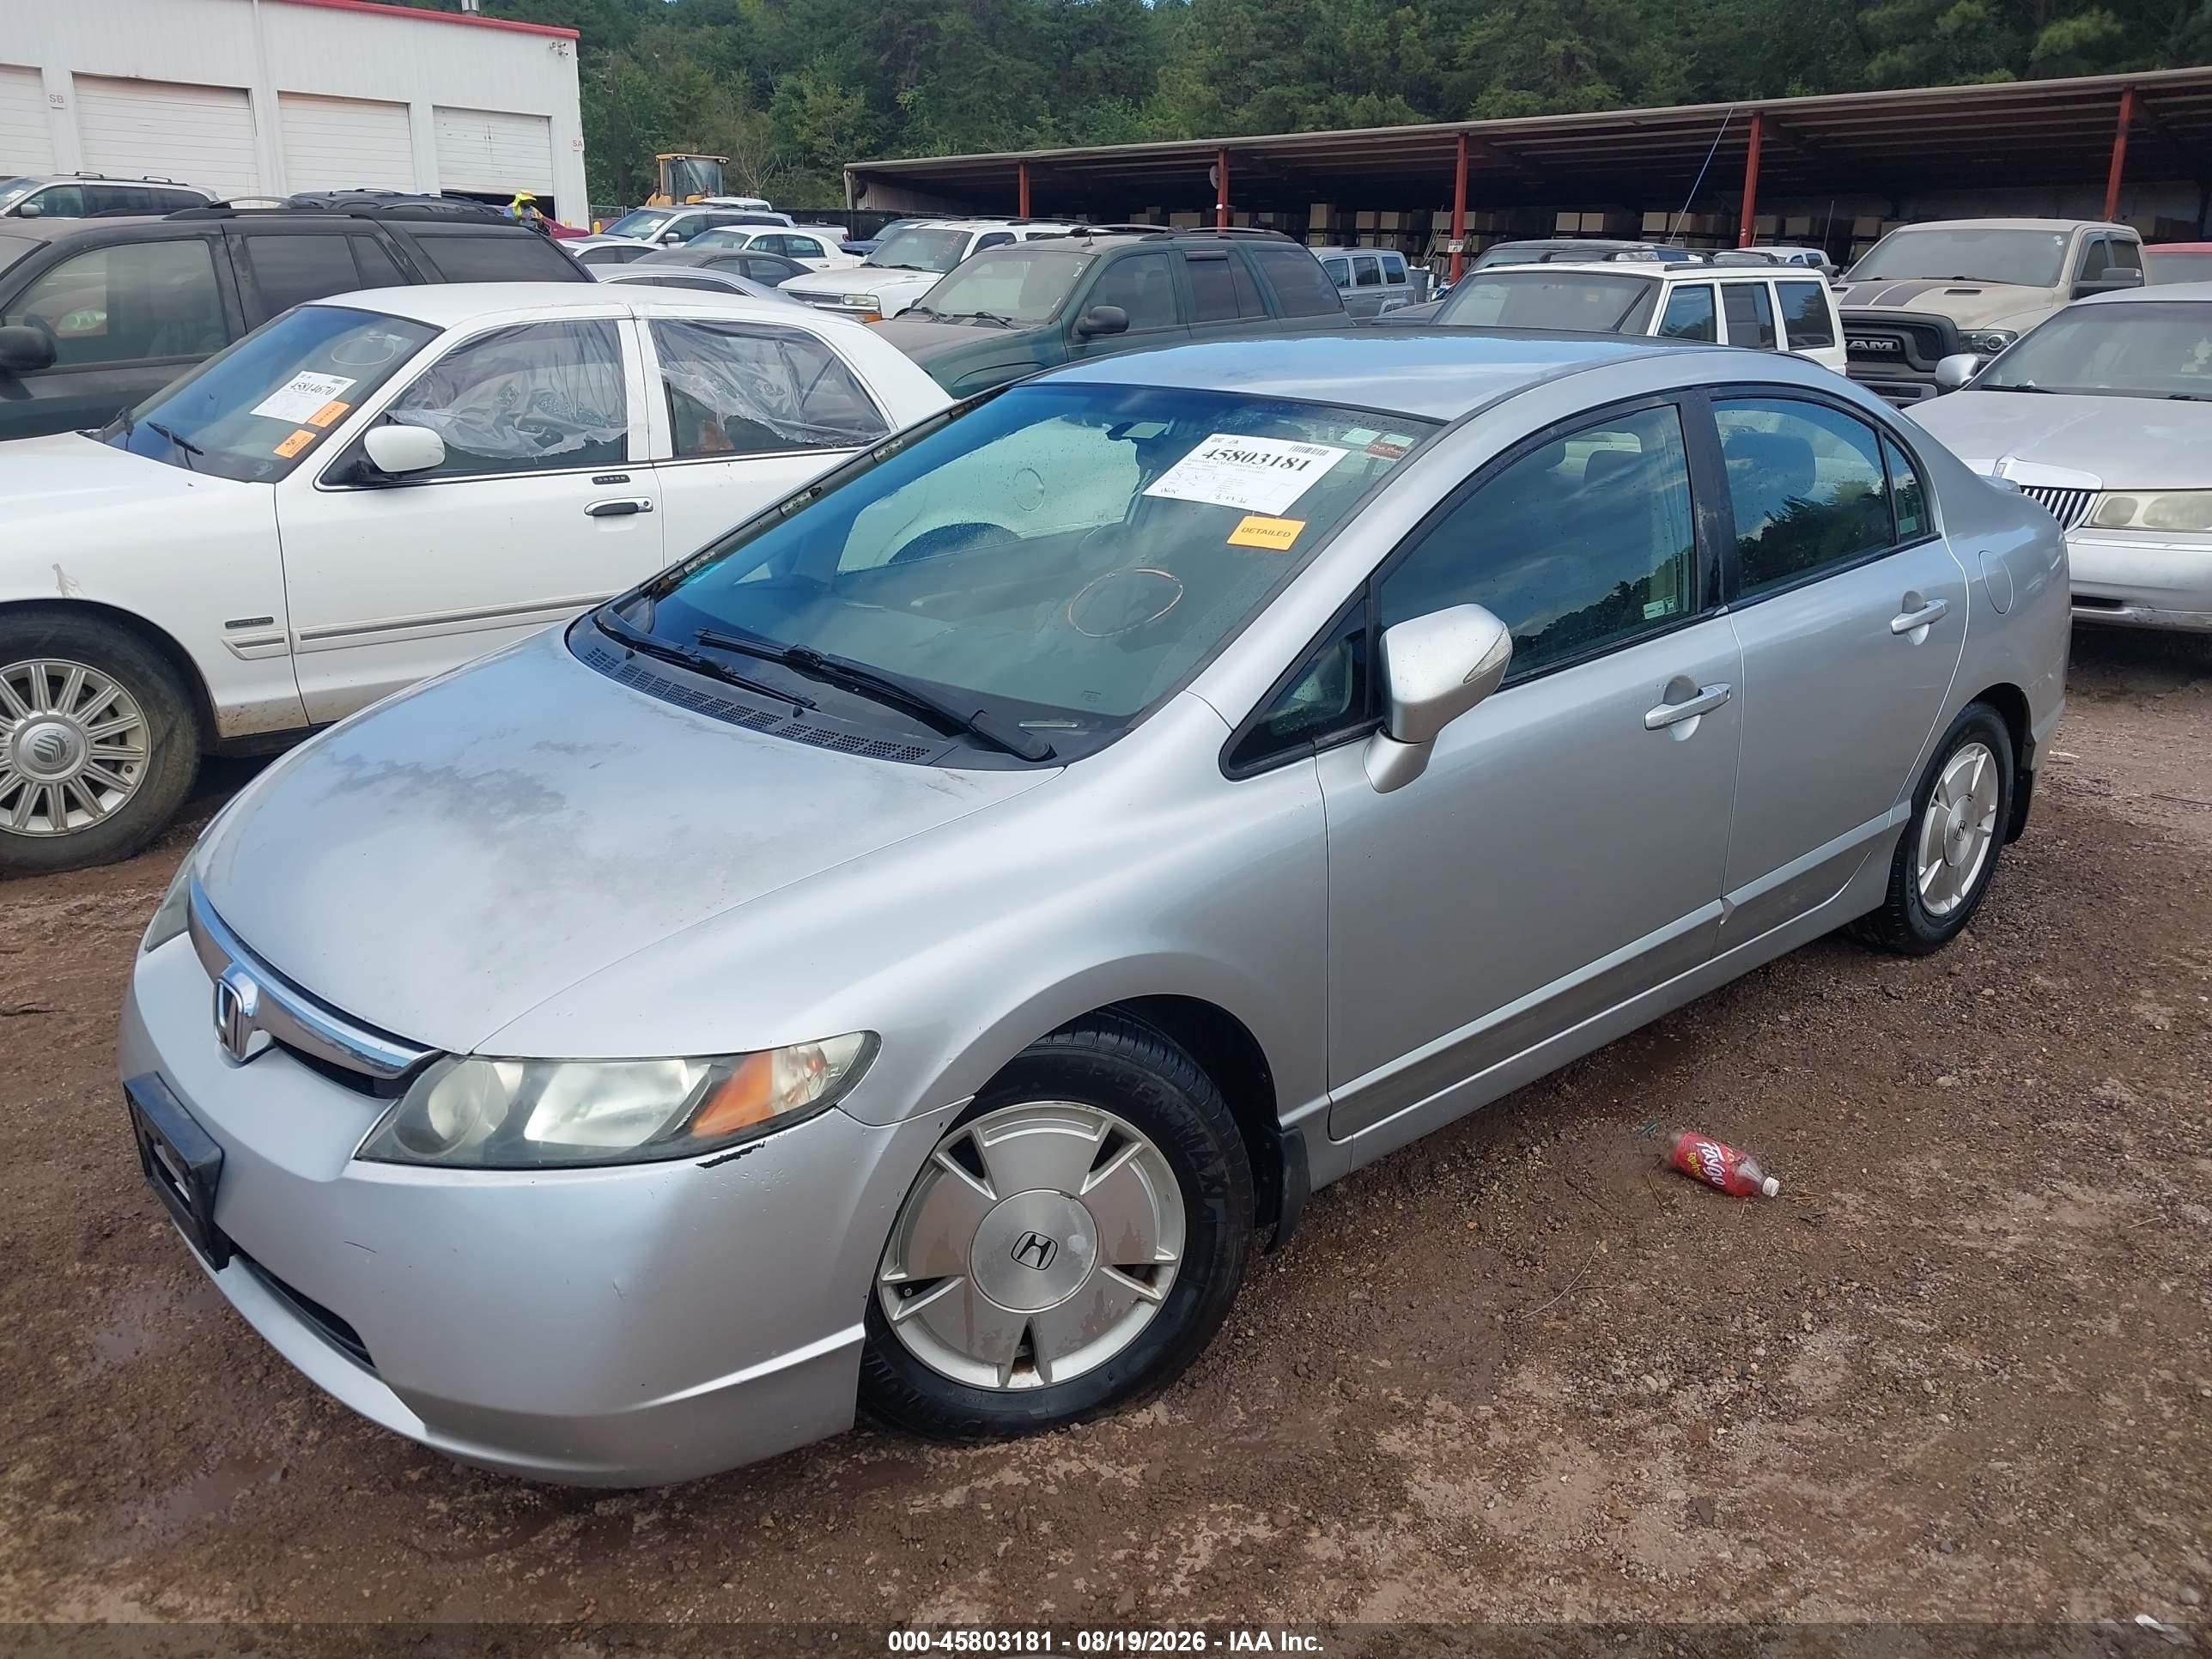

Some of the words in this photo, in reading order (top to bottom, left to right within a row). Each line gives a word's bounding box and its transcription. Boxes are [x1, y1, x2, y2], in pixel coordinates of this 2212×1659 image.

[48, 94, 64, 104] SB
[572, 139, 583, 148] SA
[1845, 340, 1894, 350] AM
[1202, 447, 1312, 472] 45803181
[1241, 526, 1291, 538] DETAILED
[1695, 1142, 1726, 1185] Faygo
